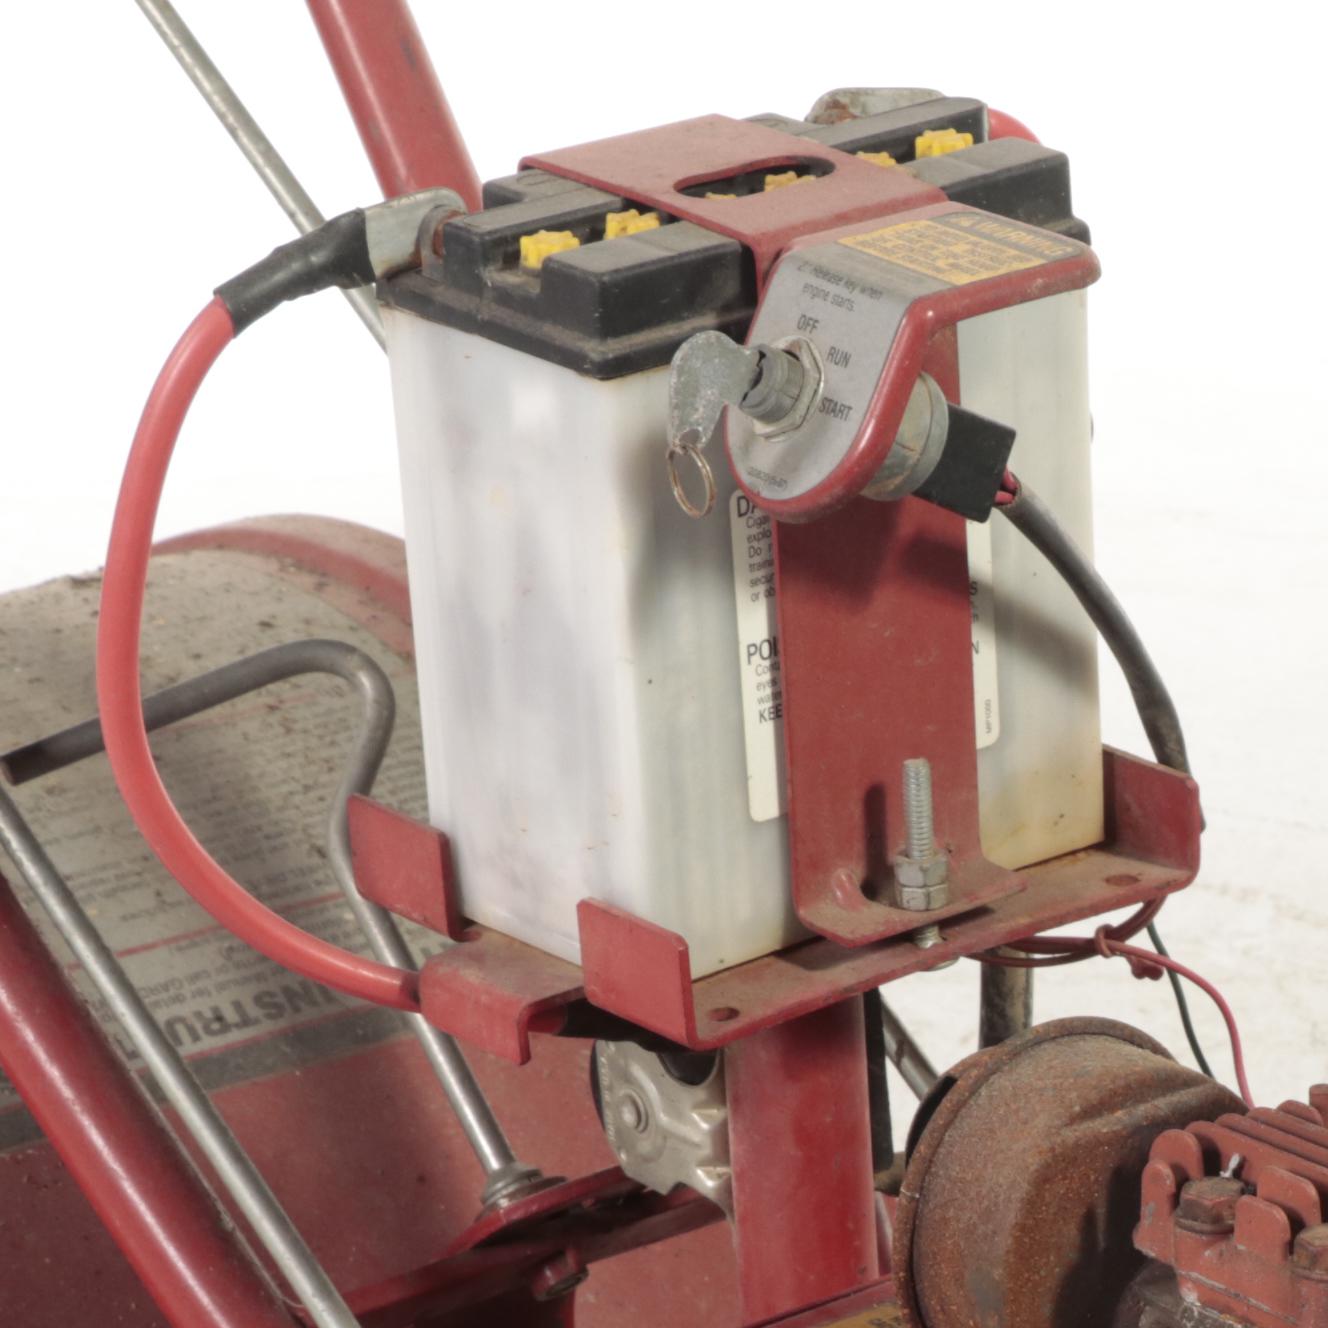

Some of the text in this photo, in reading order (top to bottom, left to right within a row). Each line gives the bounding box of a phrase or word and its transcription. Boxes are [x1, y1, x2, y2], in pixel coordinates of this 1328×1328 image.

[802, 282, 830, 300] engine
[797, 314, 819, 334] OFF
[827, 346, 851, 368] RUN
[818, 397, 853, 421] START
[748, 545, 762, 558] Do
